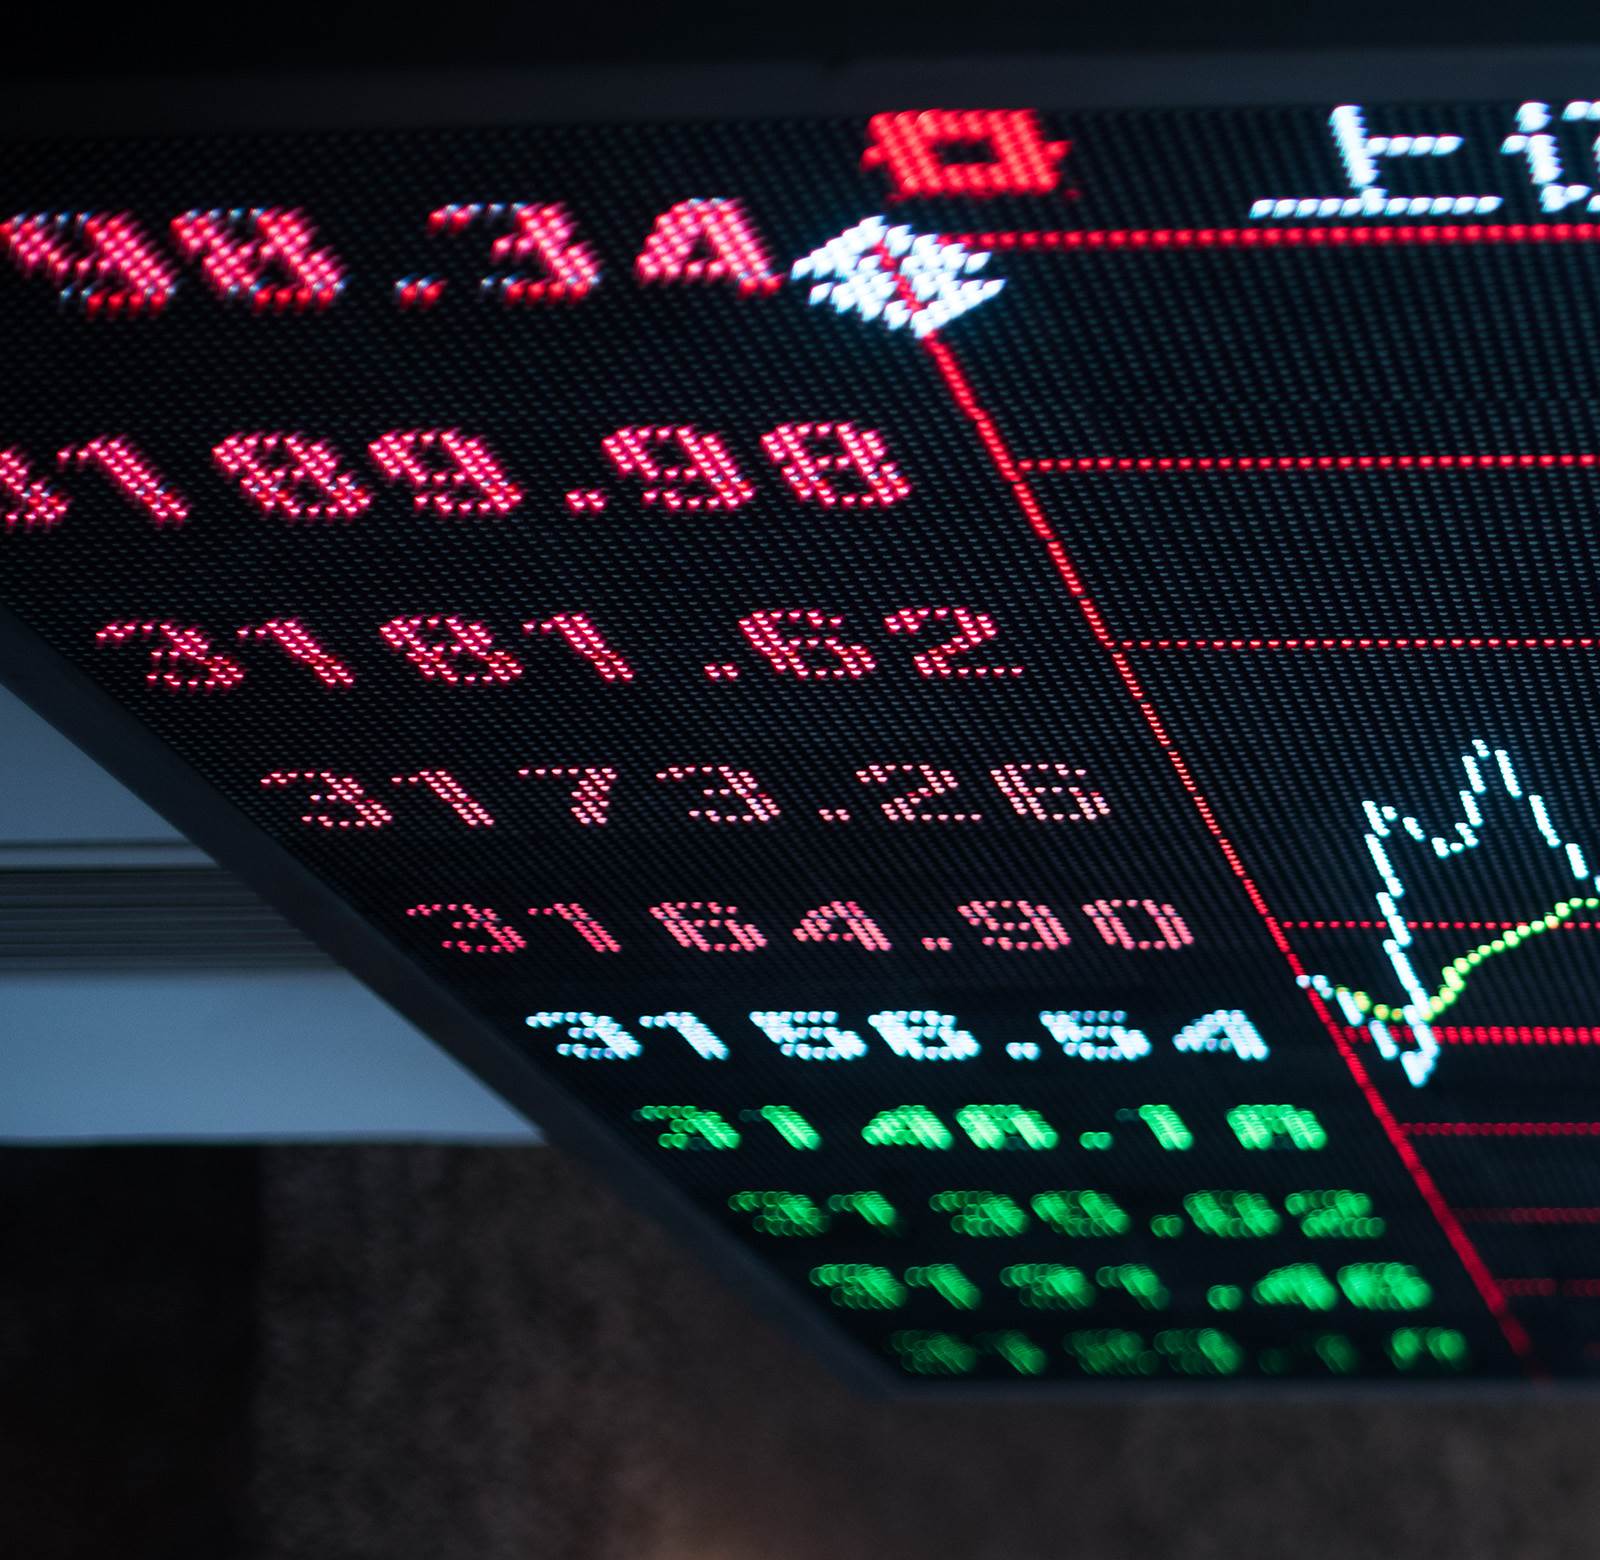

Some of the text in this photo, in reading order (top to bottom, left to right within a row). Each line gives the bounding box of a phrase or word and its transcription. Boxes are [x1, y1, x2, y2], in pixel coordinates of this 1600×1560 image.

[97, 606, 1023, 688] 3181.62
[260, 763, 1109, 827] 3173.26
[406, 899, 1193, 953] 3164.90
[526, 1009, 1269, 1061] 3156.54
